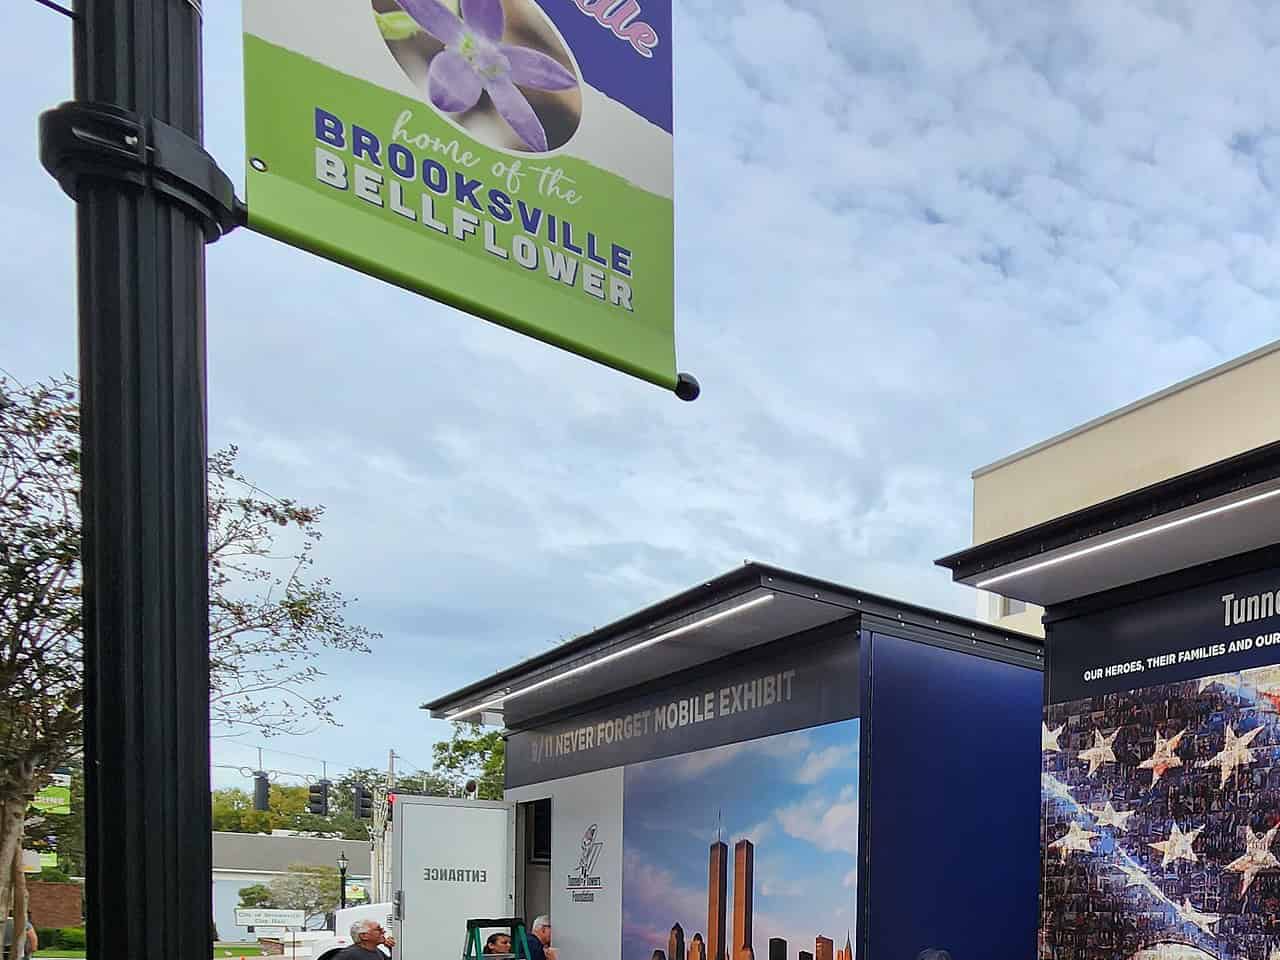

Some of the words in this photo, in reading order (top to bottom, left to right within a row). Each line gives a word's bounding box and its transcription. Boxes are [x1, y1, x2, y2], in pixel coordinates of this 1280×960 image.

[314, 106, 634, 279] BROOKSVILLE
[391, 109, 481, 168] home
[491, 159, 527, 194] of
[527, 165, 583, 204] the
[316, 147, 635, 313] BELLFLOWER
[1083, 667, 1104, 682] OUR
[1105, 660, 1145, 680] HEROES,
[1147, 653, 1177, 669] THEIR
[1178, 643, 1226, 664] FAMILIES
[1228, 637, 1254, 653] AND
[1255, 632, 1280, 648] OUR
[555, 725, 594, 758] NEVER
[596, 708, 652, 748] FORGET
[654, 691, 715, 734] MOBILE
[719, 669, 796, 717] EXHIBIT
